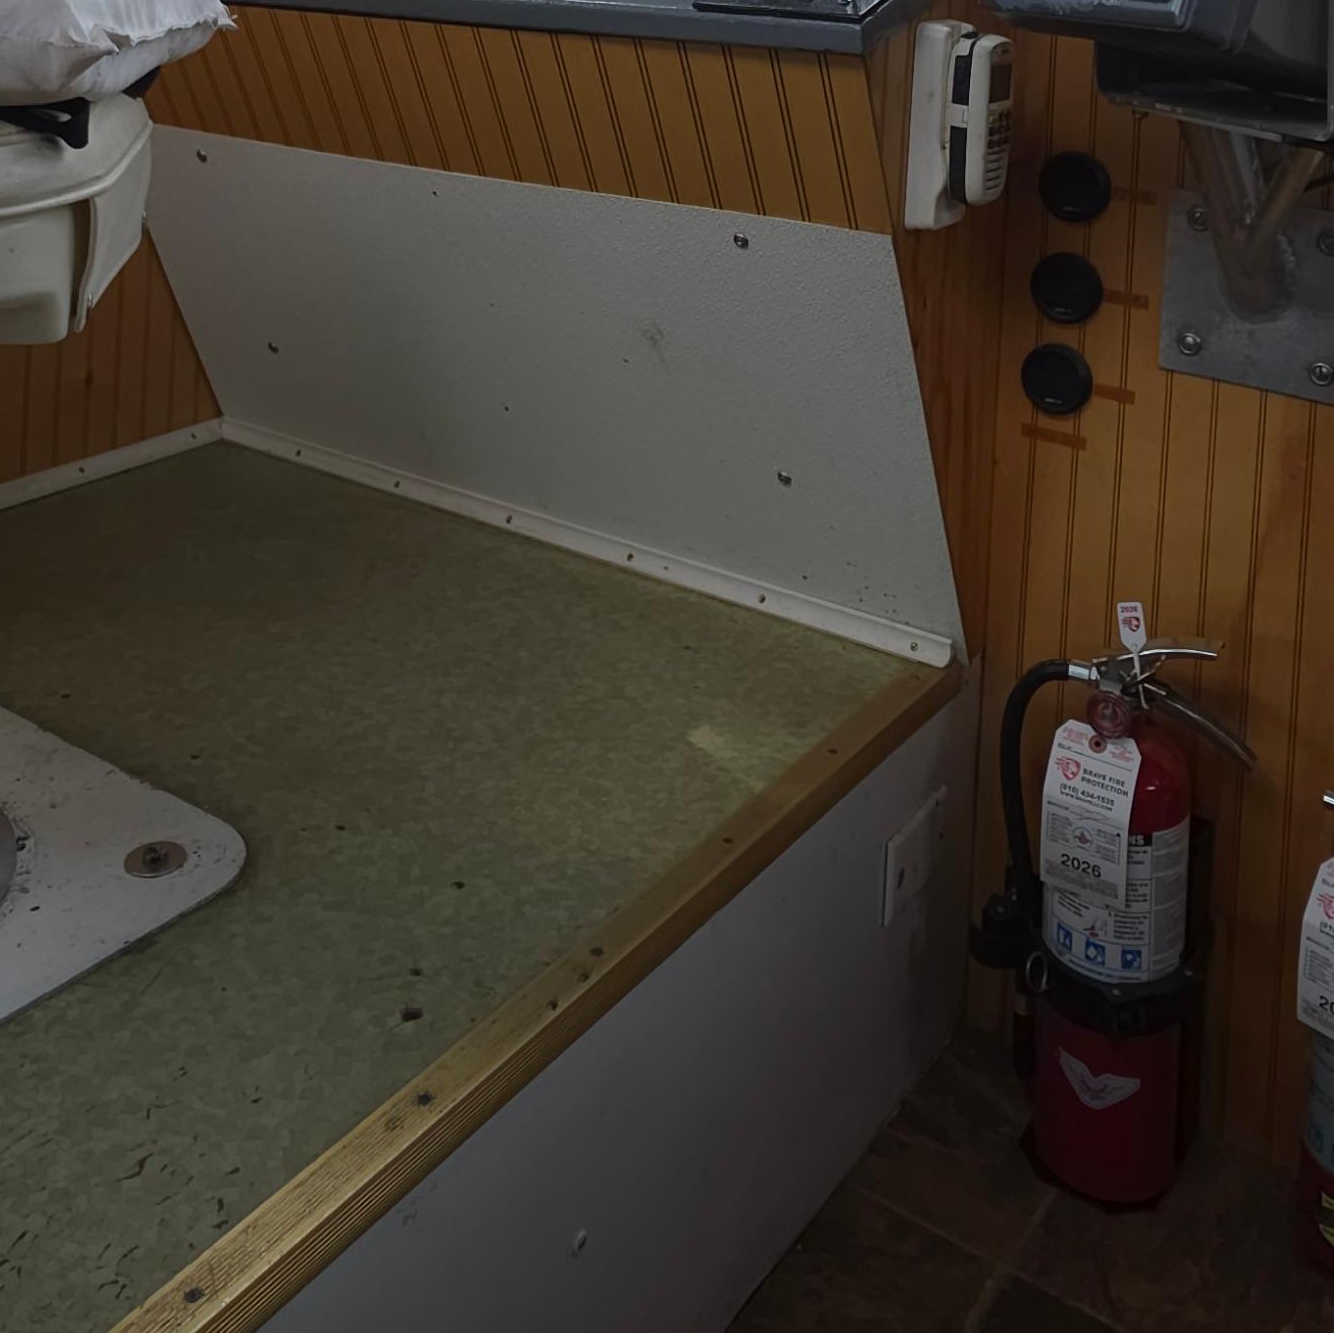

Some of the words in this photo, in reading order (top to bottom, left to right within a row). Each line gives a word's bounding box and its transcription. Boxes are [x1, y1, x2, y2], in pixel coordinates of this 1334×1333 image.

[1081, 776, 1129, 797] PROTECTION
[1083, 768, 1107, 782] BRAVE
[1108, 776, 1125, 787] FIRE
[1061, 853, 1101, 879] 2026
